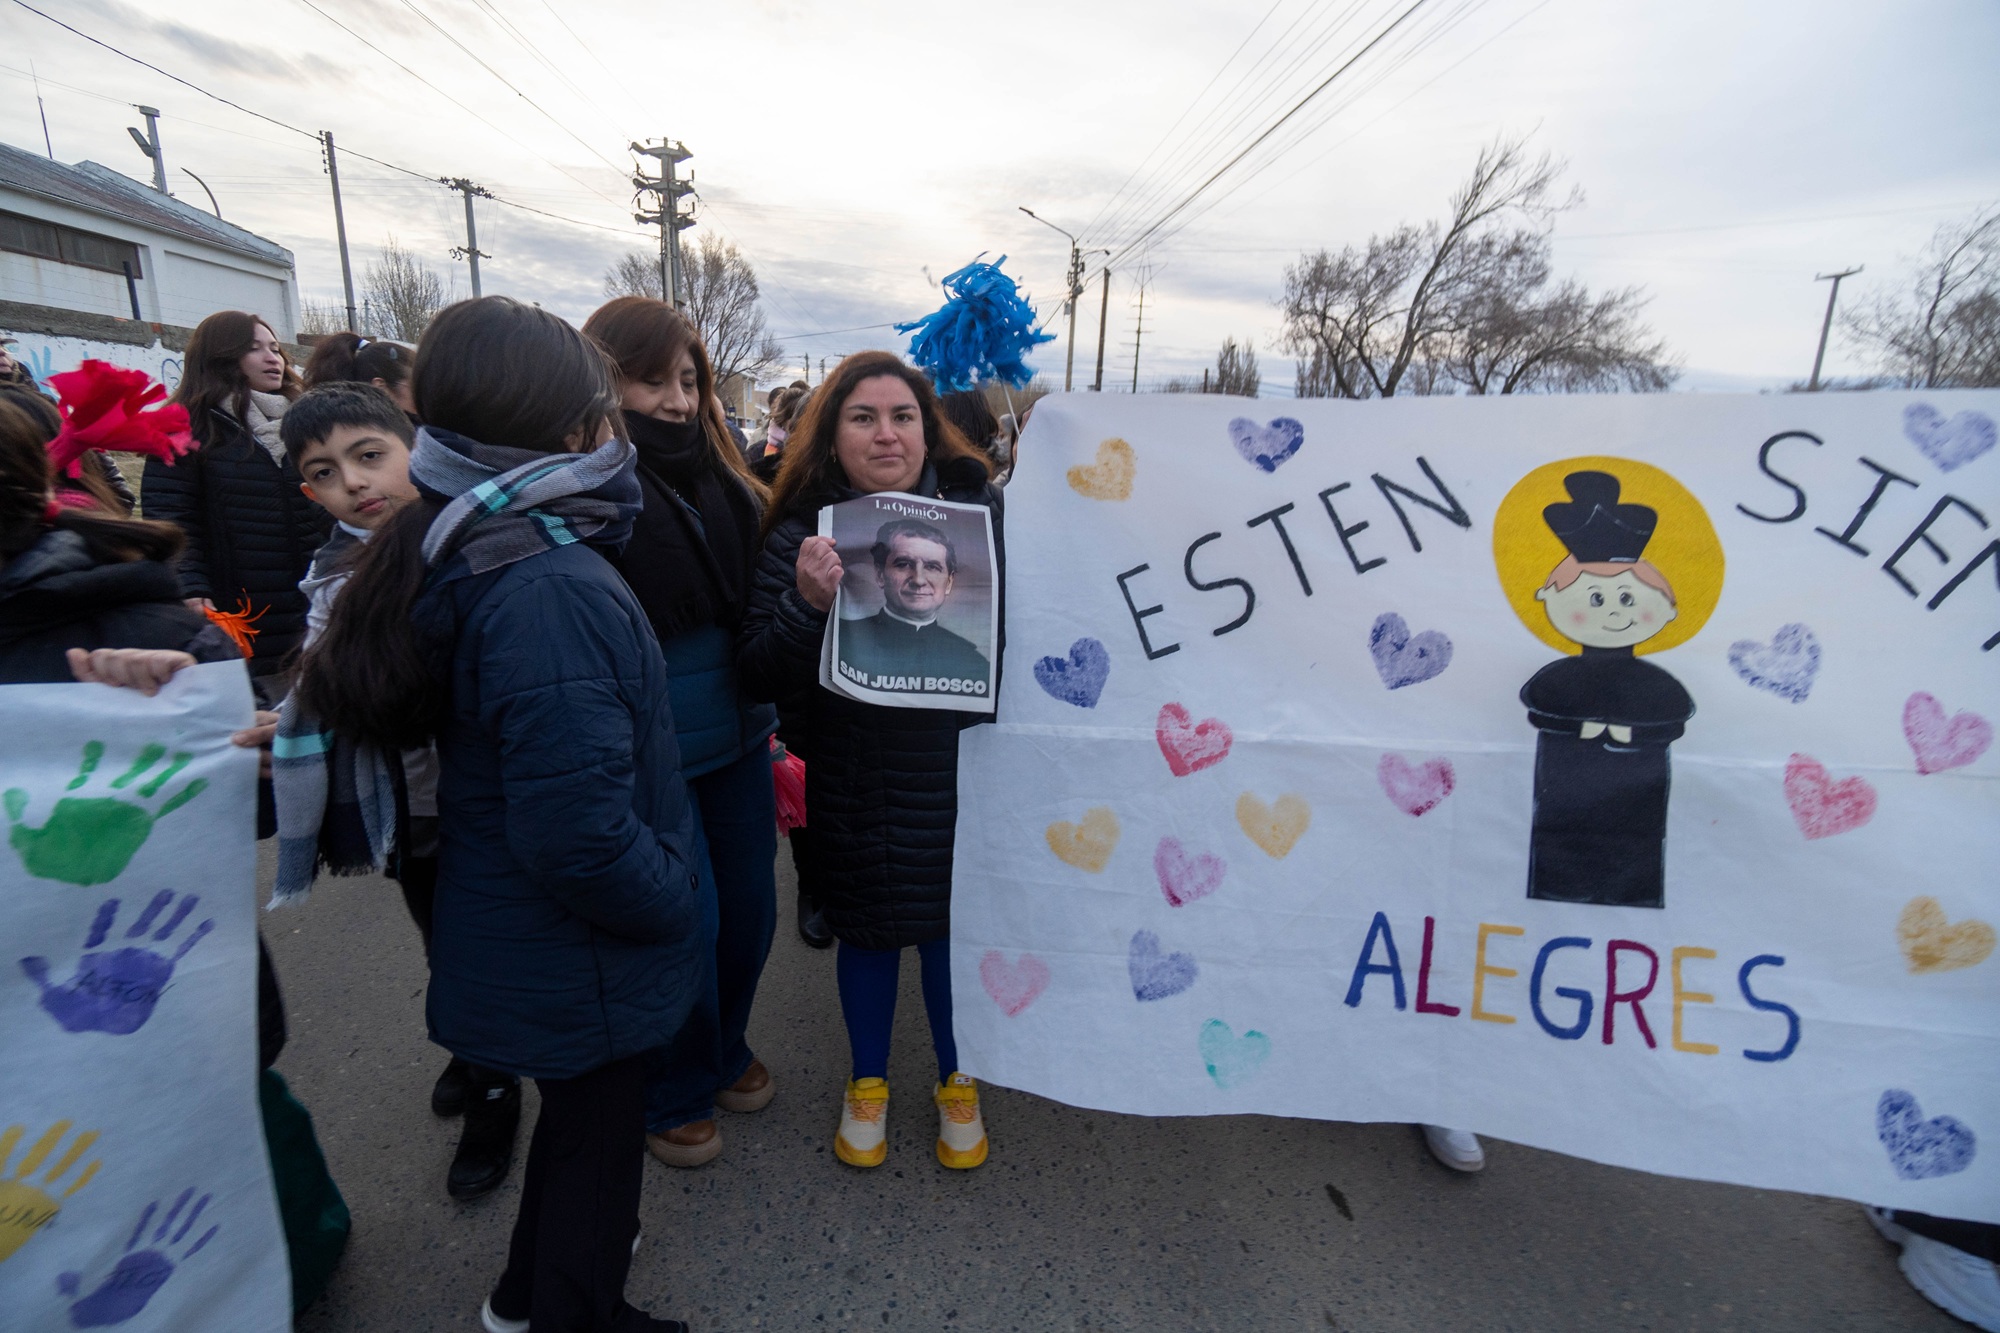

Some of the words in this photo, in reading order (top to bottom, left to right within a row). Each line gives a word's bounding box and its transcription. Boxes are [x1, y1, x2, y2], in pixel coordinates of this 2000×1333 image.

[1116, 455, 1473, 661] ESTEN
[840, 660, 868, 686] SAN
[870, 675, 922, 691] JUAN
[924, 677, 987, 695] BOSCO
[1344, 911, 1801, 1062] ALEGRES
